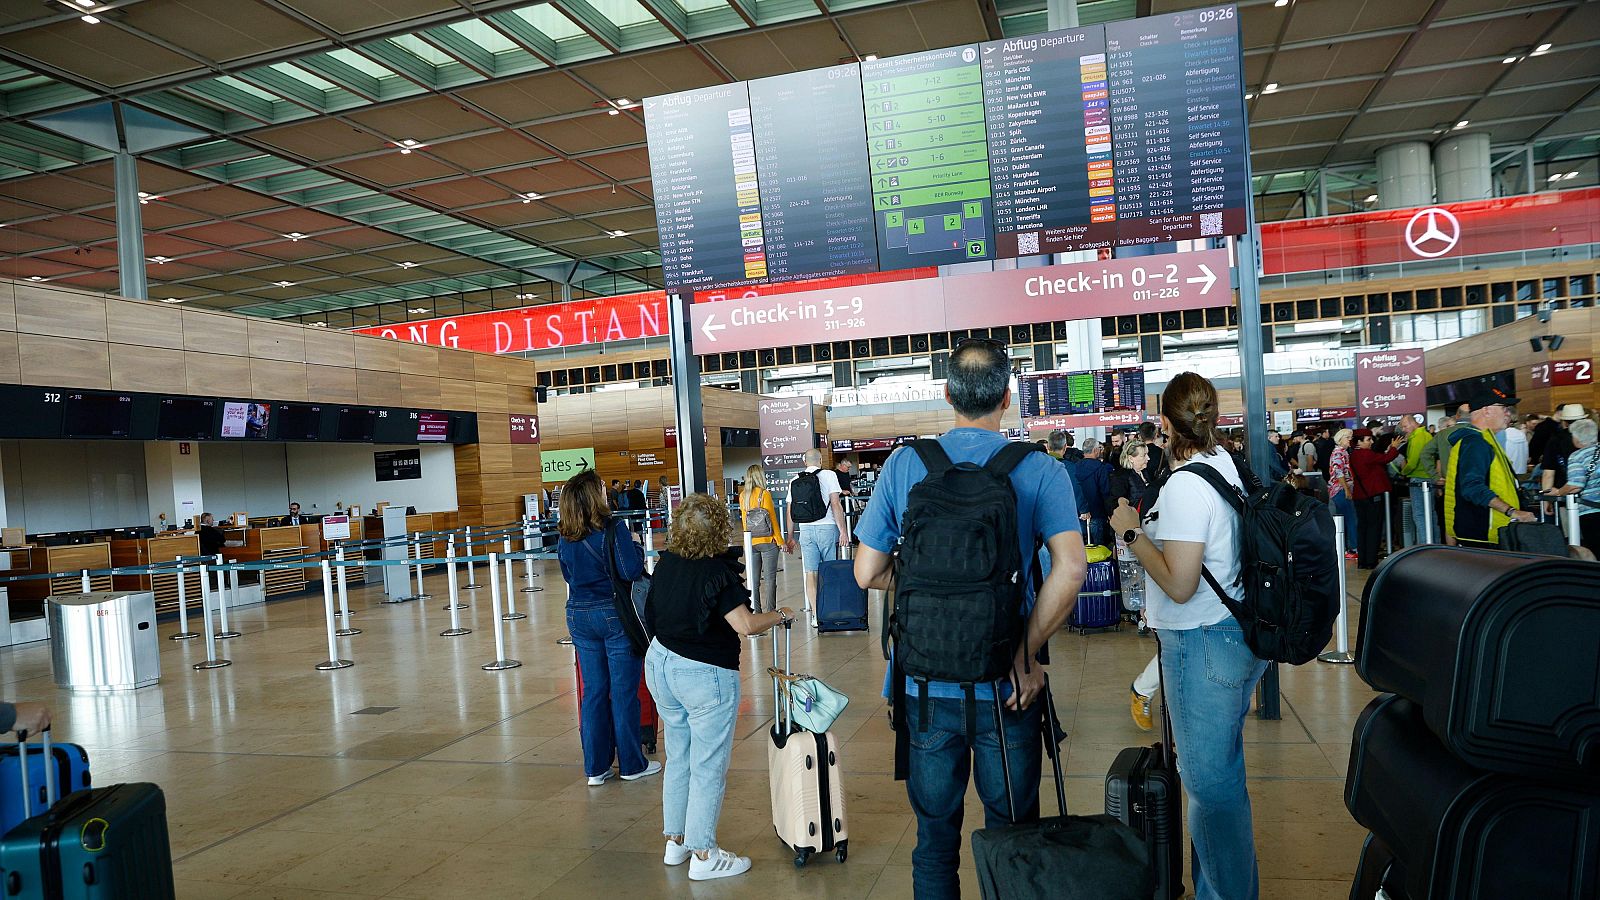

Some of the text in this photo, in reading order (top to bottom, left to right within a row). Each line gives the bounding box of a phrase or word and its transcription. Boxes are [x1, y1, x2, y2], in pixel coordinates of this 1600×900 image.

[1199, 8, 1233, 23] 09:26
[1003, 33, 1085, 53] Abflug Departure
[864, 51, 957, 70] Wartezeit Sicherheitskontrolle
[828, 68, 857, 79] 09:26
[1186, 67, 1219, 77] Abfertigung
[662, 89, 732, 106] Abflug Departure
[926, 96, 940, 104] 4-9
[1008, 102, 1029, 110] Mailand
[1188, 103, 1219, 113] Self Service
[928, 115, 945, 123] 5-10
[1008, 110, 1041, 120] Kopenhagen
[1188, 114, 1198, 122] Self
[1008, 119, 1037, 128] Zakynthos
[1009, 129, 1022, 137] Split
[1010, 137, 1027, 145] Zürich
[1189, 139, 1223, 149] Abfertigung
[1025, 143, 1044, 151] Canaria
[1011, 153, 1042, 161] Amsterdam
[1013, 171, 1039, 179] Hurghada
[1191, 167, 1224, 176] Abfertigung
[1014, 179, 1039, 187] Frankfurt
[1037, 186, 1056, 194] Airport
[1192, 184, 1224, 193] Abfertigung
[824, 194, 852, 203] Abfertigung
[945, 190, 964, 198] Runway
[1150, 208, 1174, 216] 611-616
[1163, 223, 1193, 231] Departures
[714, 279, 758, 288] Sicherheitskontrolle
[1025, 269, 1124, 296] Check-in
[731, 300, 817, 326] Check-in
[1372, 354, 1397, 362] Abflug
[1576, 361, 1591, 380] 2
[1378, 374, 1410, 382] Check-in
[44, 393, 60, 403] 312
[530, 419, 537, 438] 3
[541, 459, 572, 473] ates
